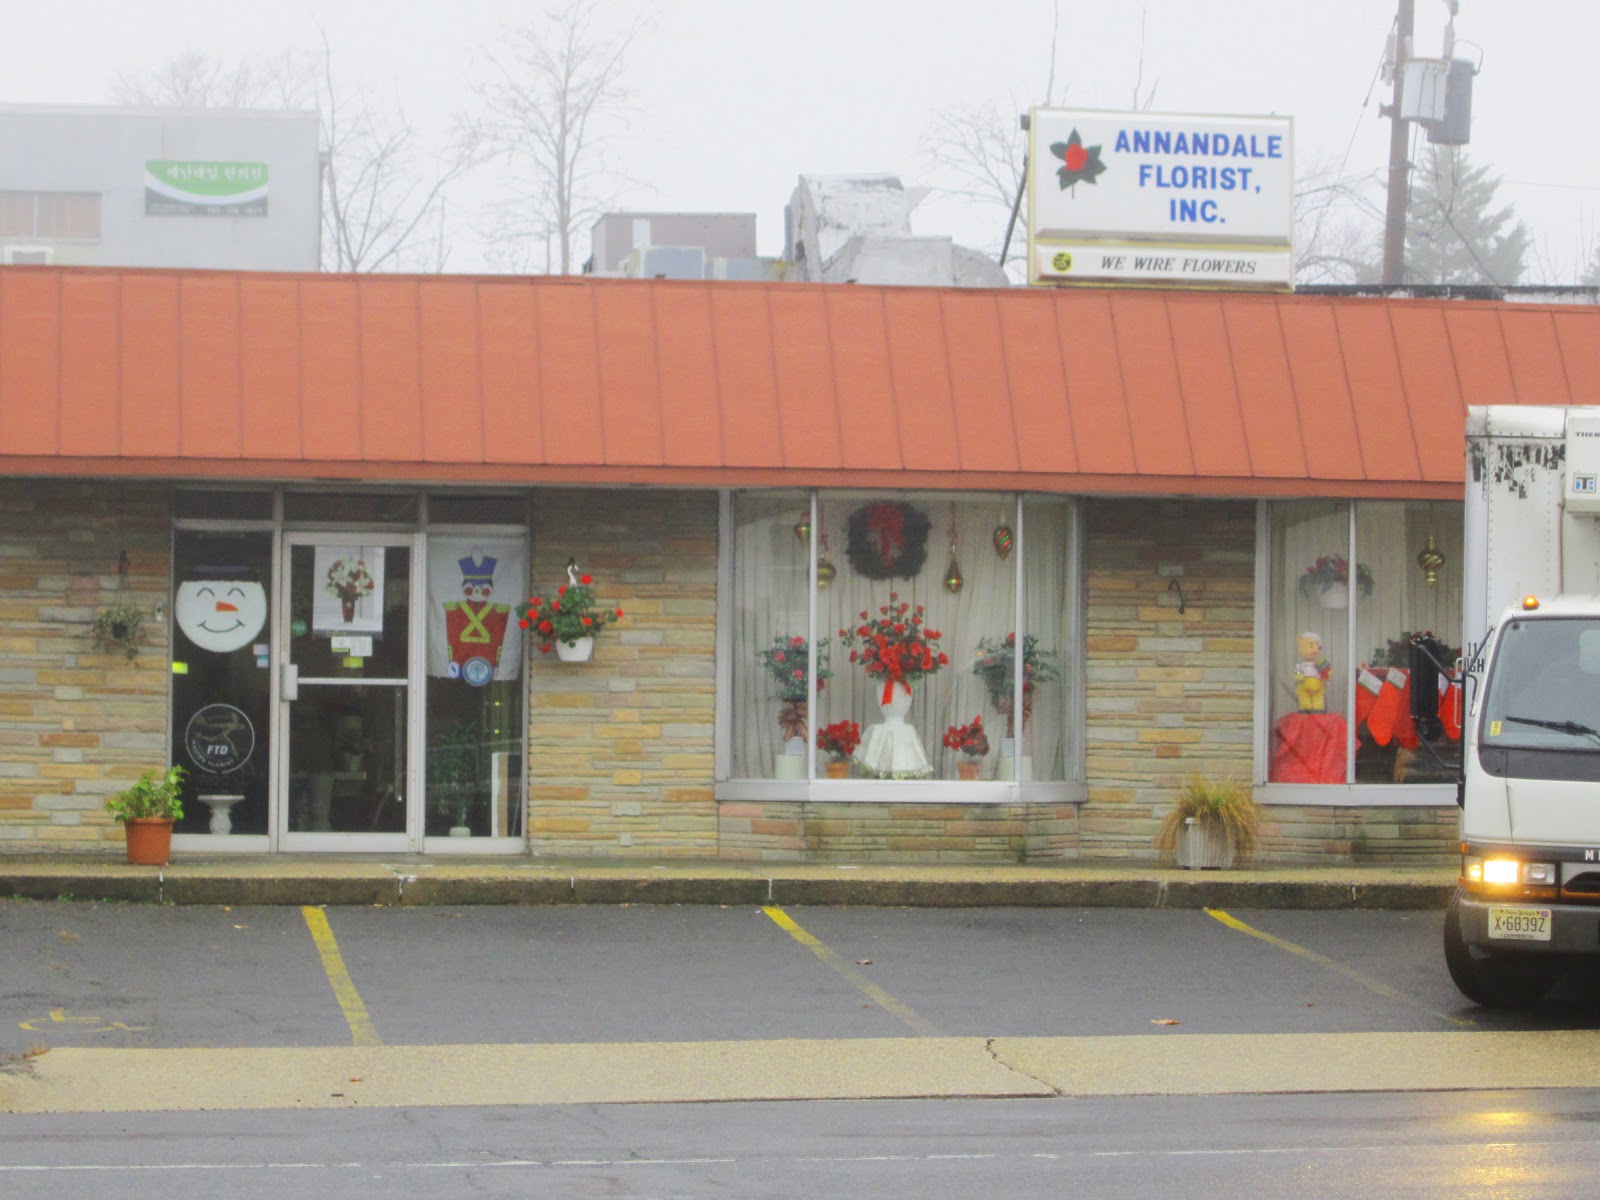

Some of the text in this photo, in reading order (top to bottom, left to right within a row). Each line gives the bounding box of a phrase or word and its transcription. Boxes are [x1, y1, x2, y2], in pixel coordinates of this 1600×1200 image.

[1114, 129, 1282, 159] ANNANDALE
[1139, 165, 1261, 193] FLORIST,
[1169, 199, 1226, 223] INC.
[1101, 255, 1257, 275] WE WIRE FLOWERS
[207, 745, 228, 755] FTD
